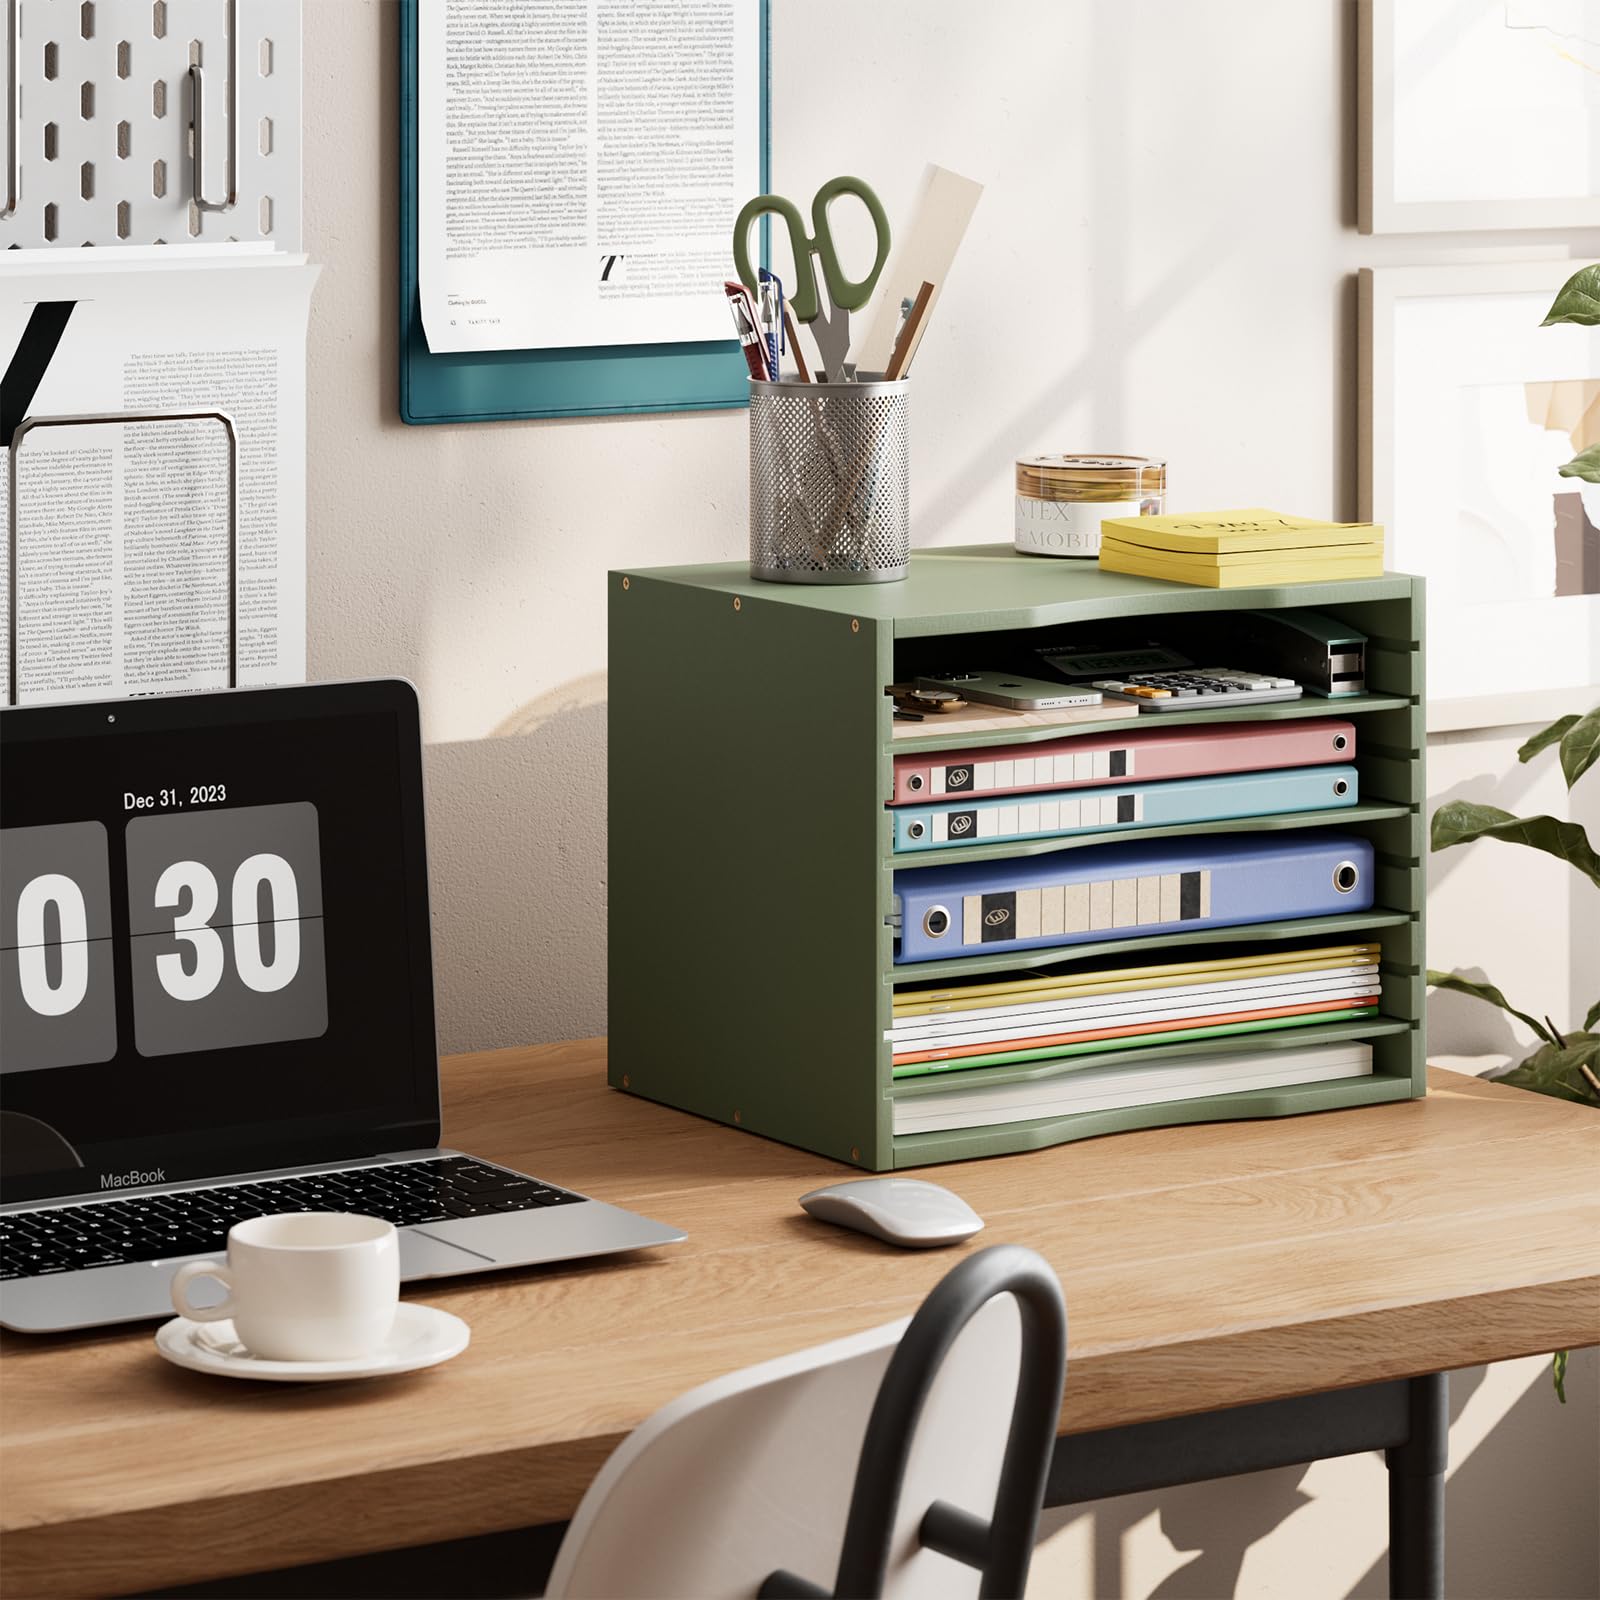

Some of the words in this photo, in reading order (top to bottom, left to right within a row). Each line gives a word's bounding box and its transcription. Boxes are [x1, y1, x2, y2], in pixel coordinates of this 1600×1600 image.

[600, 255, 624, 281] T
[124, 792, 155, 810] Dec
[159, 788, 183, 807] 31,
[190, 784, 227, 804] 2023
[17, 874, 88, 1016] 0
[154, 853, 300, 1001] 30
[100, 1168, 166, 1189] MacBook
